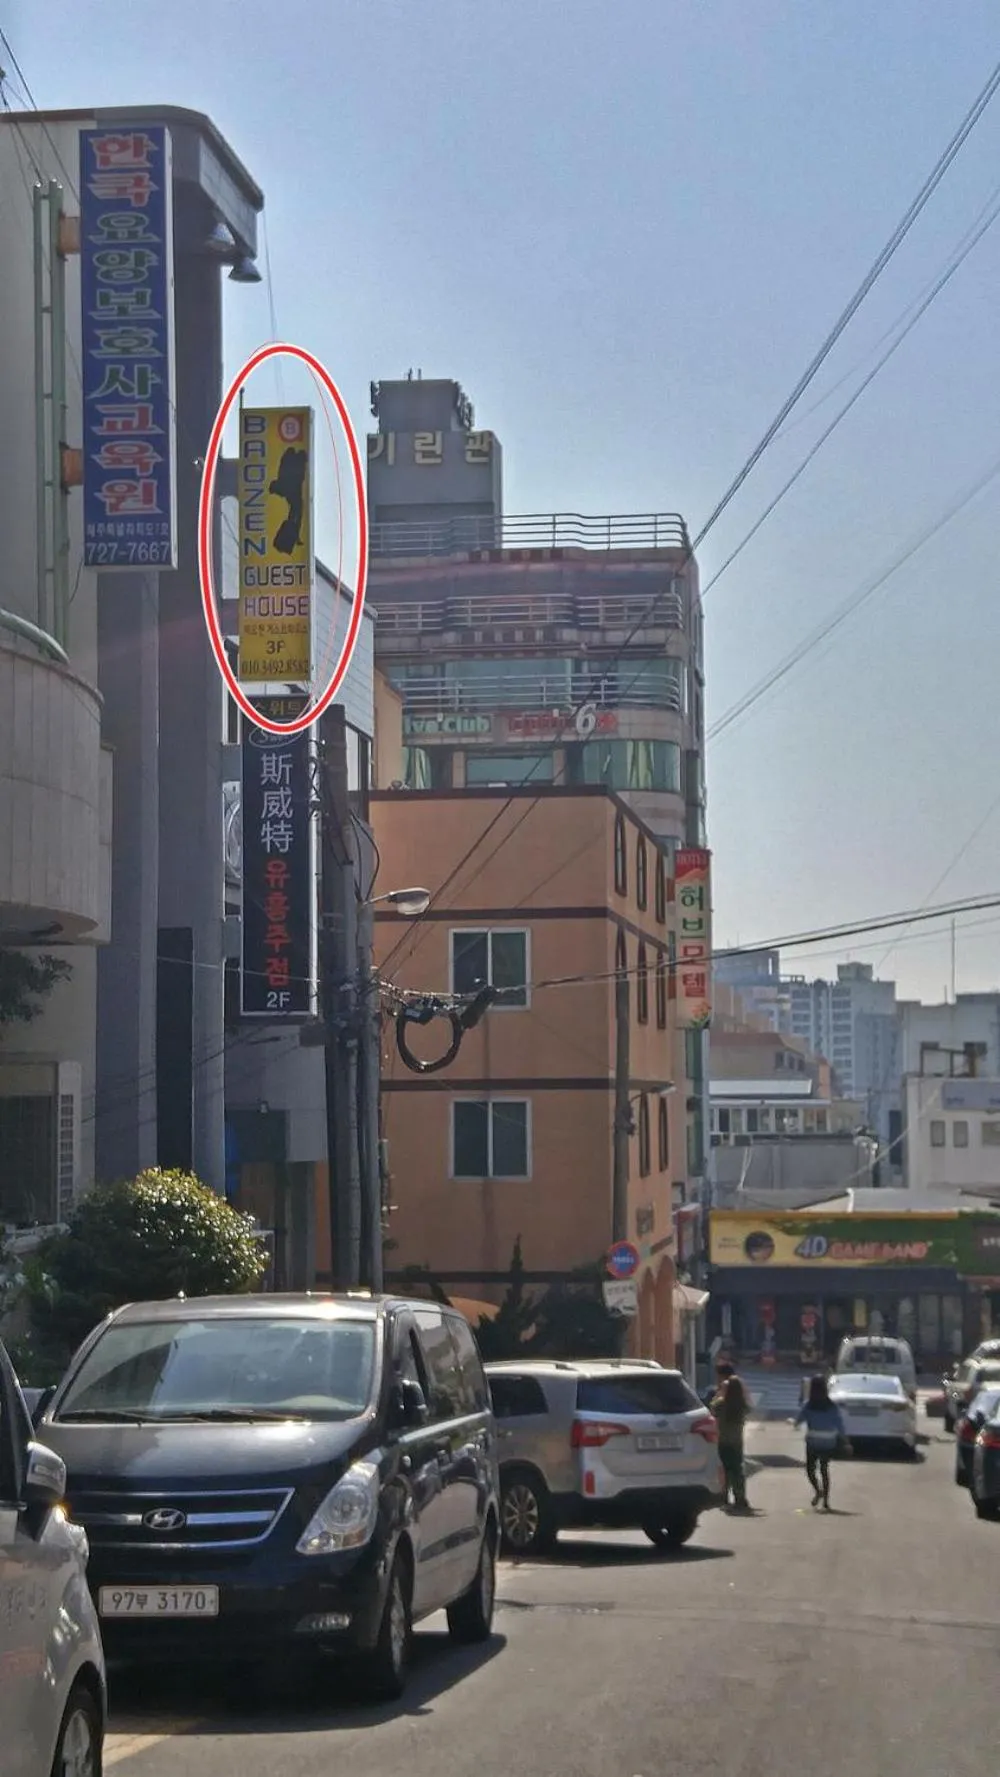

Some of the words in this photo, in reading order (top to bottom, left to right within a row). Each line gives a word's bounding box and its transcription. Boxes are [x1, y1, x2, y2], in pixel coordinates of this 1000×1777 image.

[243, 415, 266, 556] BAOZEN
[86, 541, 169, 564] 727-7667
[244, 564, 306, 586] GUEST
[244, 595, 308, 616] HOUSE
[266, 640, 285, 655] 3F
[260, 752, 294, 852] 斯威特
[264, 859, 291, 989] 유흥주점
[266, 991, 291, 1009] 2F
[112, 1591, 148, 1611] 97부
[158, 1591, 206, 1610] 3170
